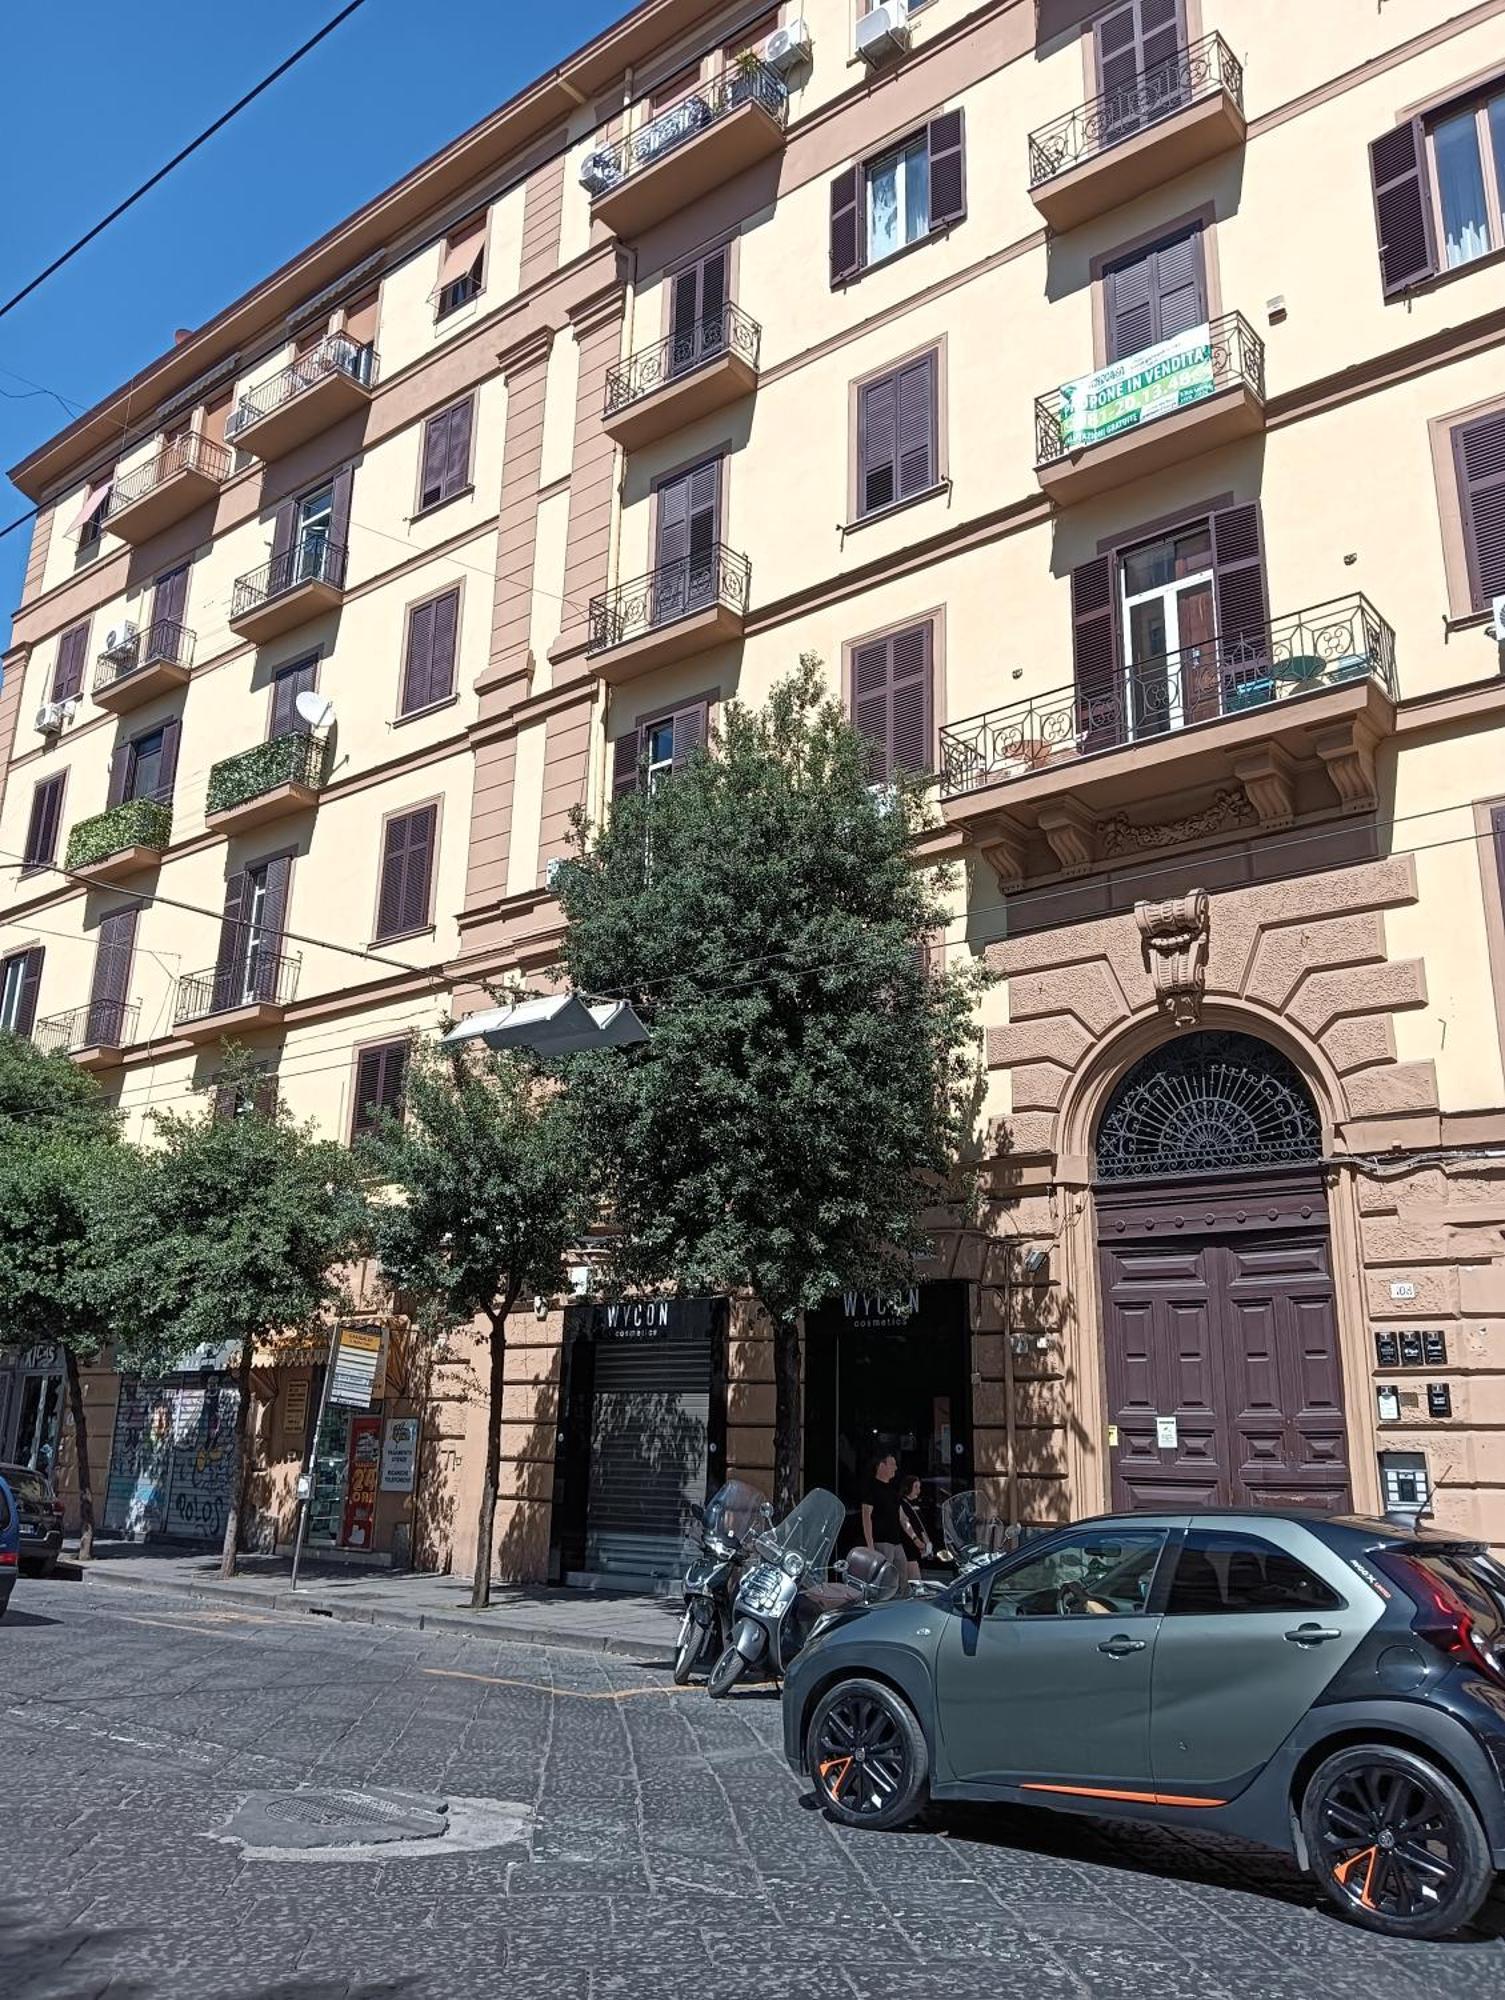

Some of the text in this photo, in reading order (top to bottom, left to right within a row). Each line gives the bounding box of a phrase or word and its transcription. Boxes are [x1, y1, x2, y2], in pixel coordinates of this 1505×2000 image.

[1128, 376, 1141, 392] IN
[1145, 347, 1204, 384] VENDITA
[607, 1302, 668, 1327] WYCON
[854, 1318, 908, 1327] cosmetics
[353, 1468, 375, 1491] 24
